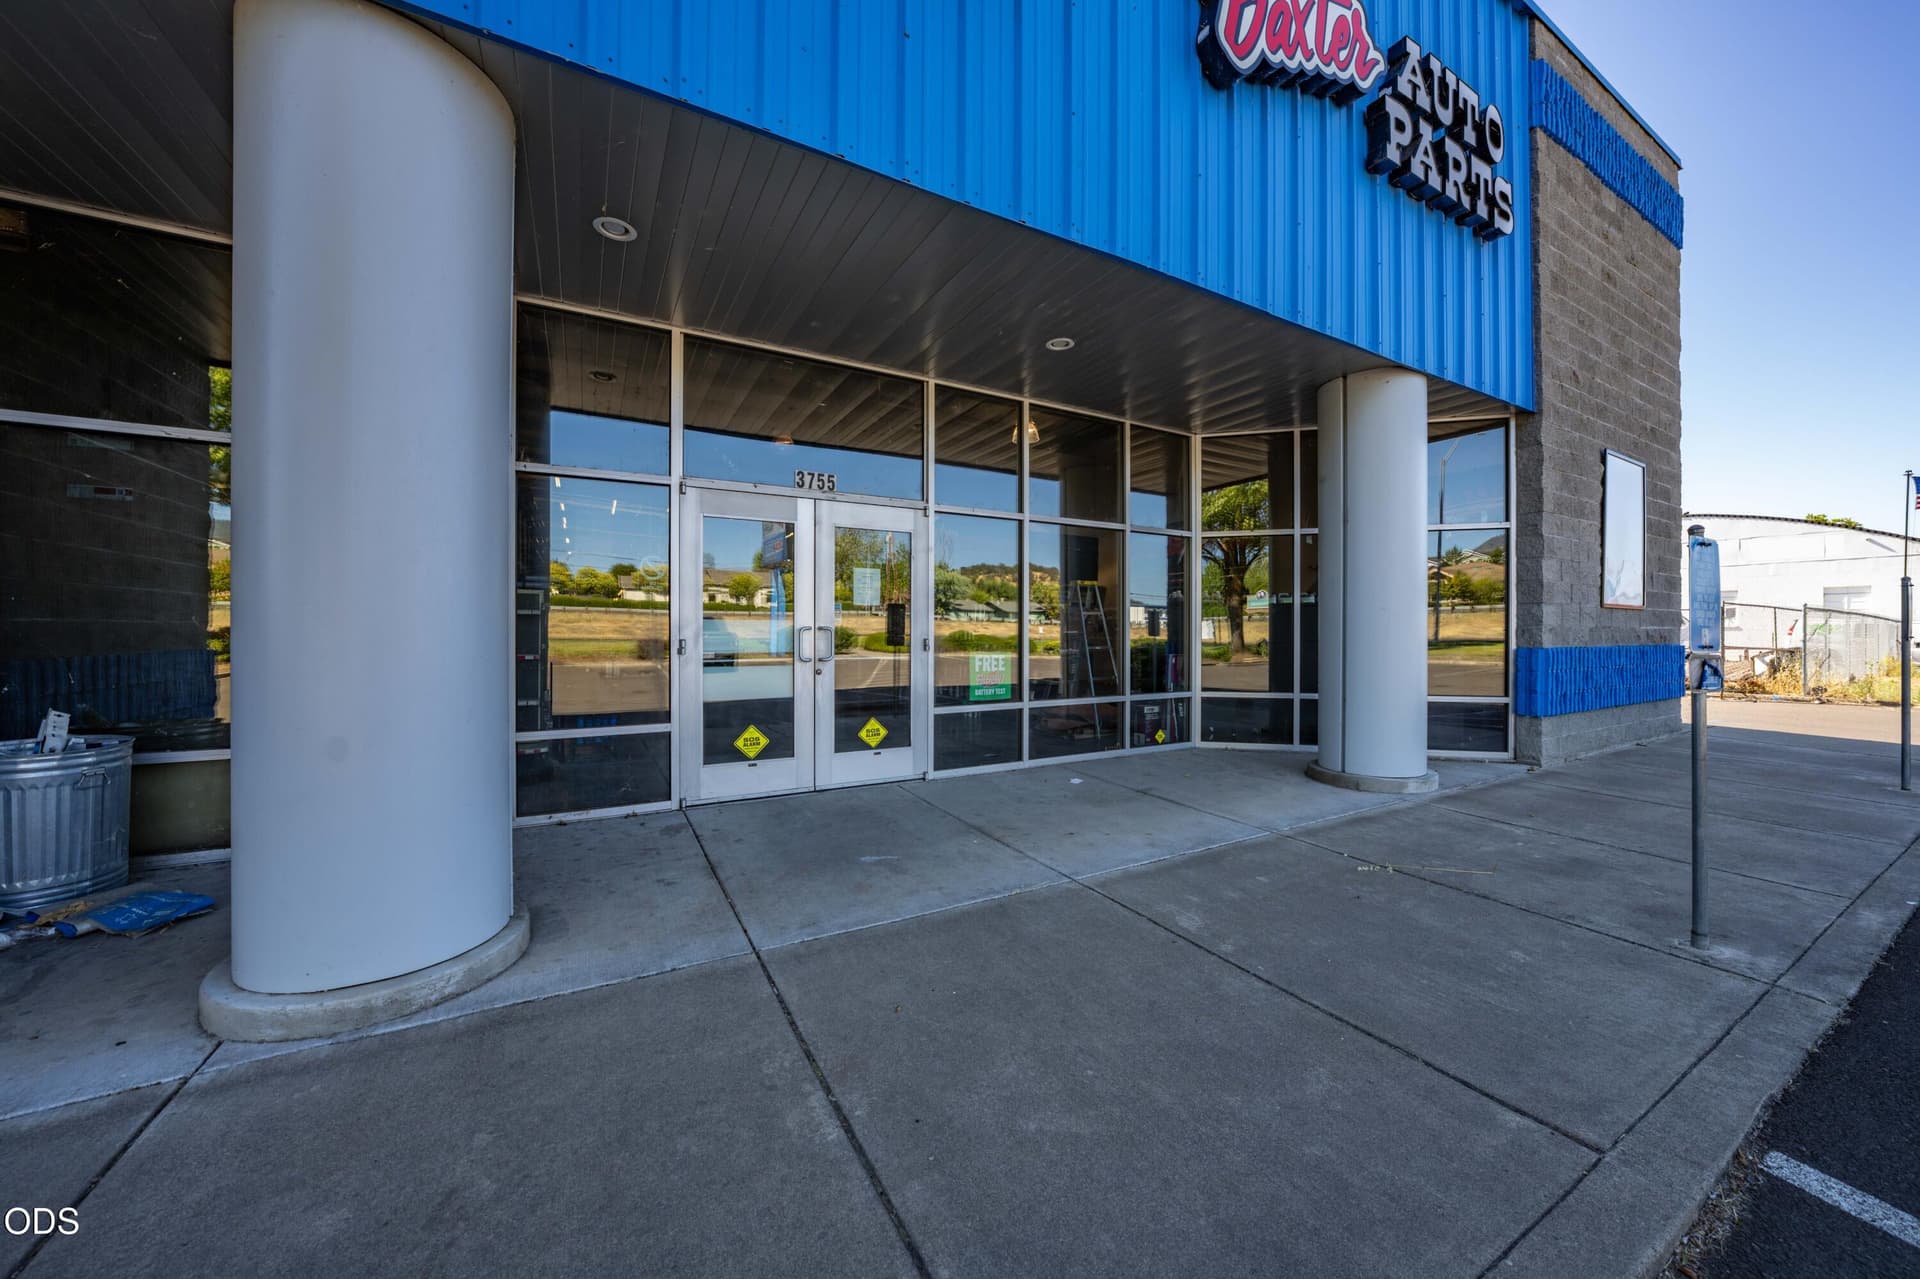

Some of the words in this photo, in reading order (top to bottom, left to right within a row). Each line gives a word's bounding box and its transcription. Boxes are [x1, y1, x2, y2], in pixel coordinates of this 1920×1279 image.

[1397, 36, 1504, 163] AUTO
[1385, 95, 1515, 235] PARTS
[796, 470, 835, 491] 3755
[975, 655, 1005, 672] FREE
